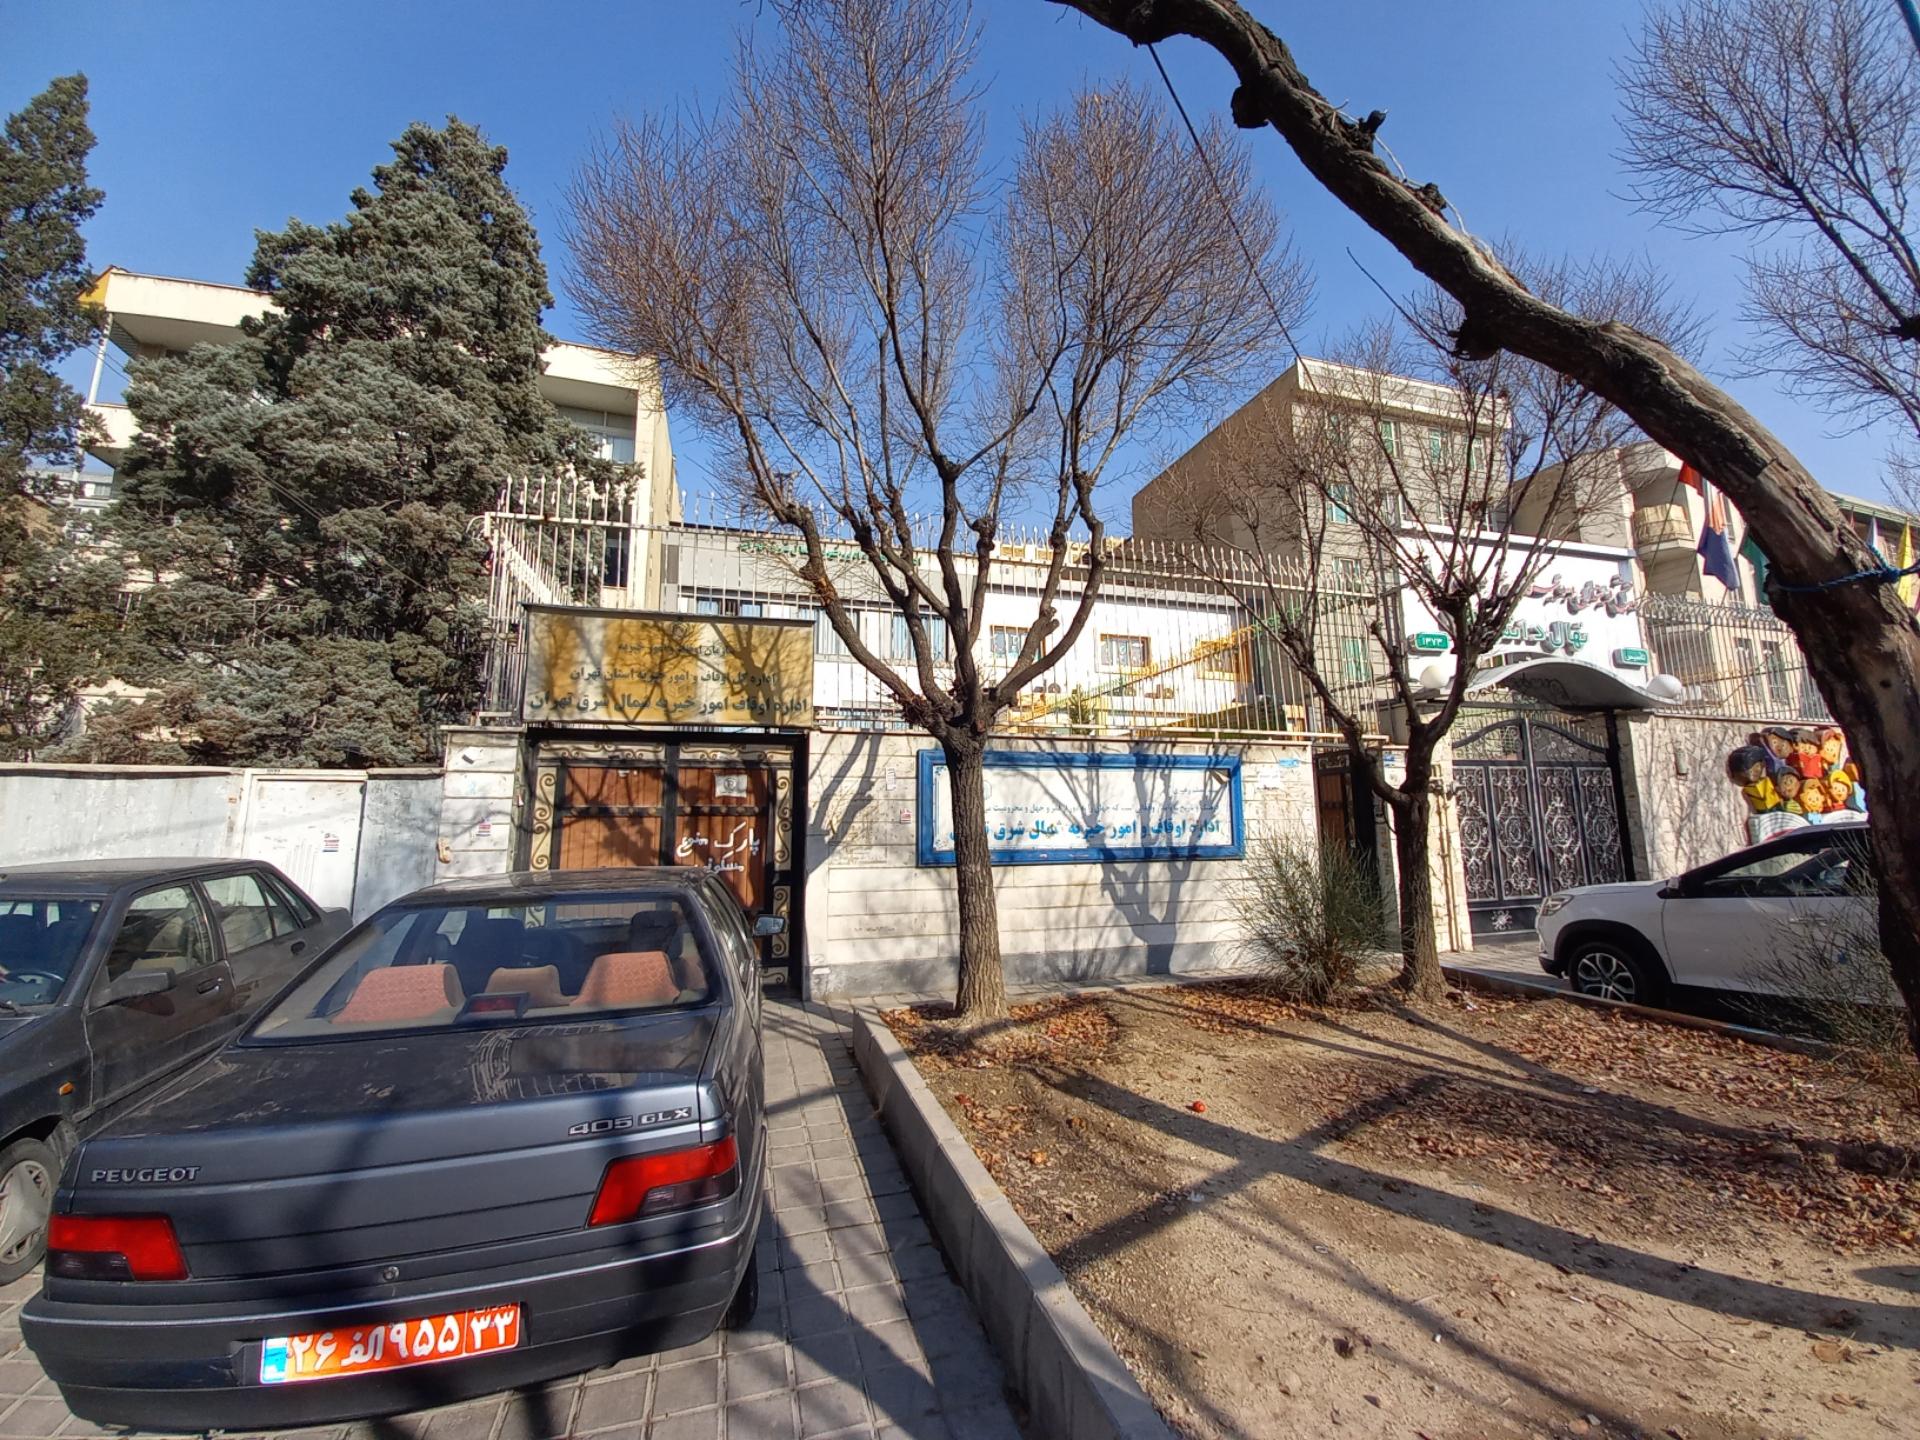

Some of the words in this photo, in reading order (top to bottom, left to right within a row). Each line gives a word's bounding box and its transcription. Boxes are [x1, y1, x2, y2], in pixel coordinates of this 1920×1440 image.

[570, 667, 601, 681] تهران
[529, 691, 573, 710] تهران
[576, 693, 609, 712] شرق
[699, 696, 729, 715] امور
[714, 820, 761, 856] پارک
[994, 819, 1026, 841] شرق
[1109, 819, 1137, 839] امور
[1151, 817, 1186, 839] اوقاف
[568, 1115, 634, 1135] 405
[639, 1107, 690, 1125] GLX
[91, 1166, 200, 1183] PEUGEOT
[470, 1310, 514, 1349] ۳۳
